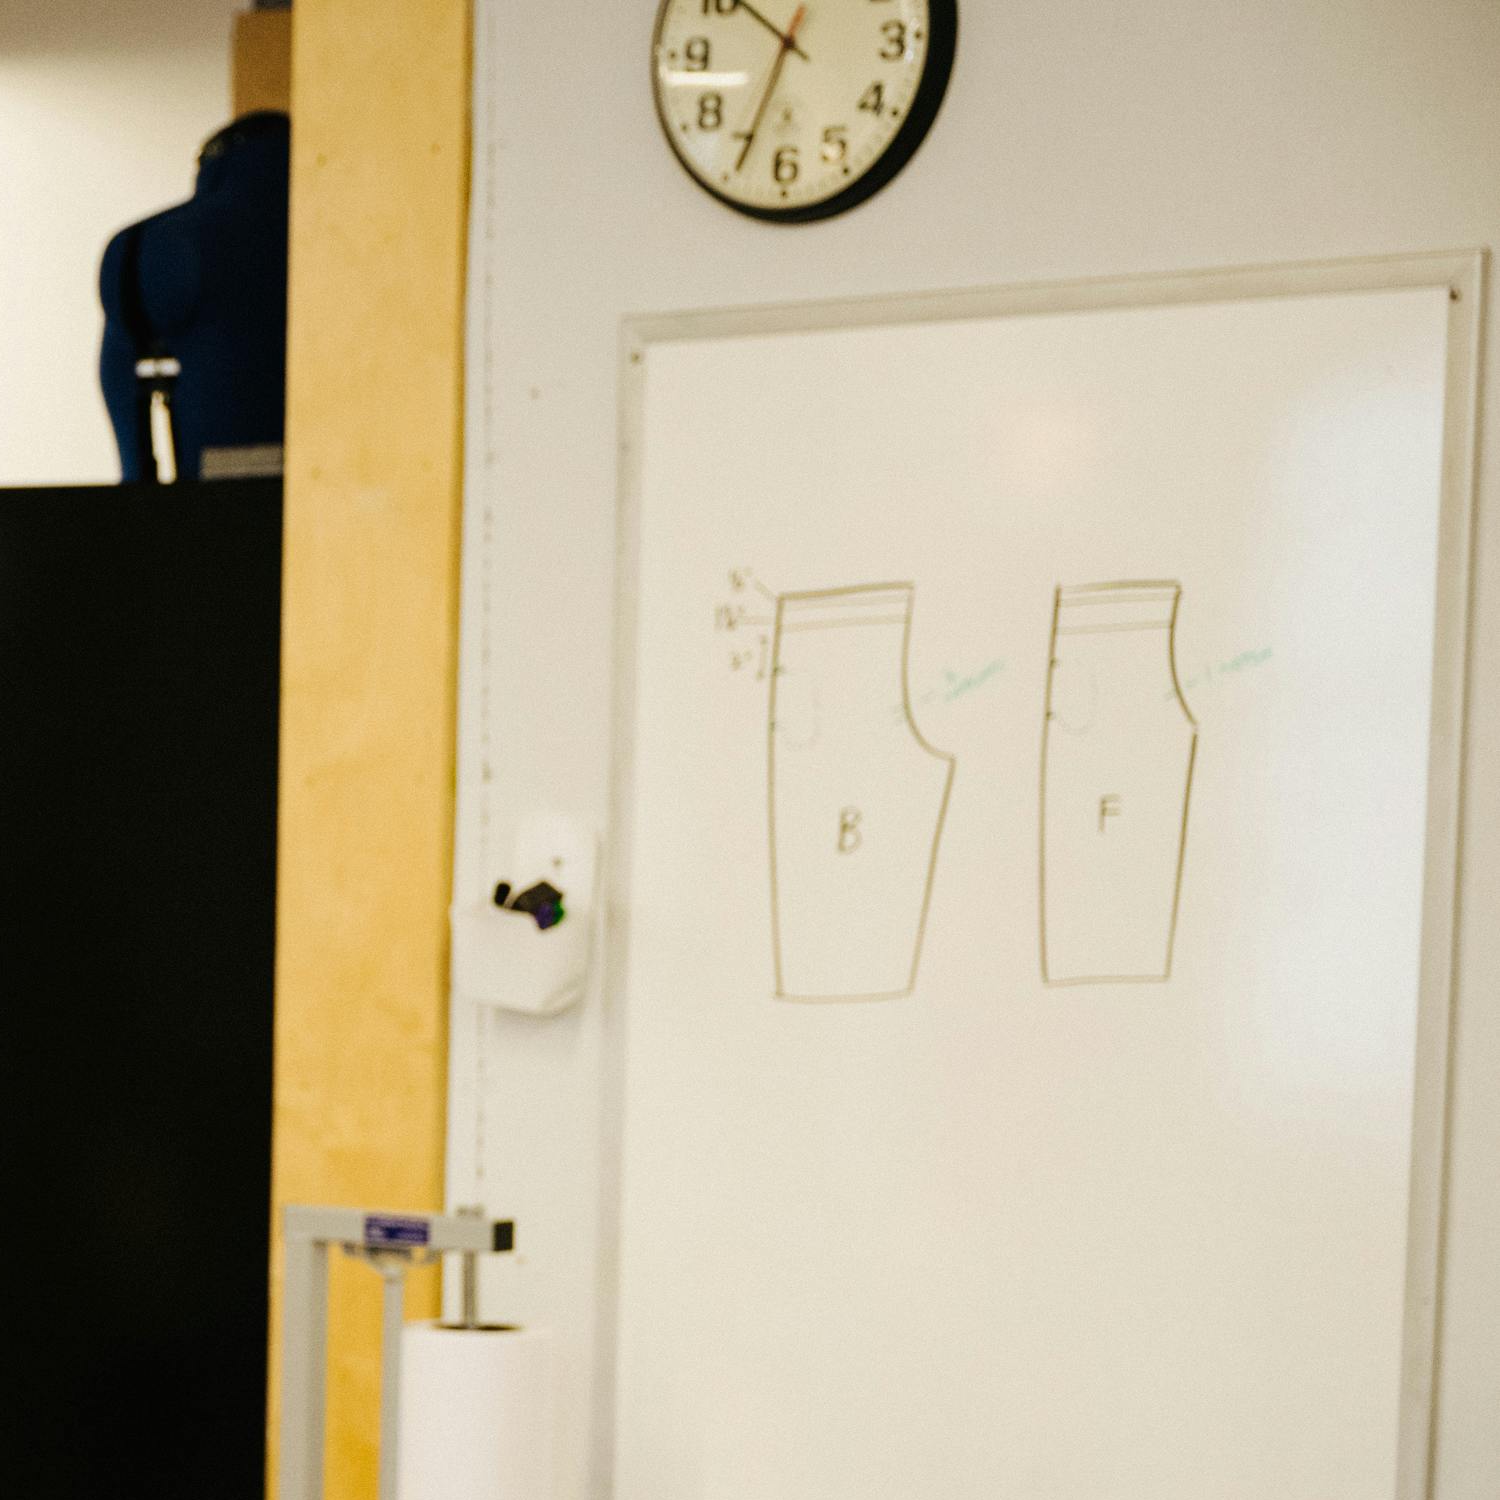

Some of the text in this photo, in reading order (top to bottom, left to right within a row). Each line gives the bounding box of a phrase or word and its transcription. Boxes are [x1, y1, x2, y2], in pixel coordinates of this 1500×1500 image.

[685, 37, 711, 72] 9
[879, 20, 906, 61] 3
[698, 91, 722, 131] 8
[858, 81, 885, 116] 4
[821, 126, 847, 162] 5
[773, 146, 799, 184] 6
[837, 806, 863, 854] B
[1098, 793, 1121, 833] F
